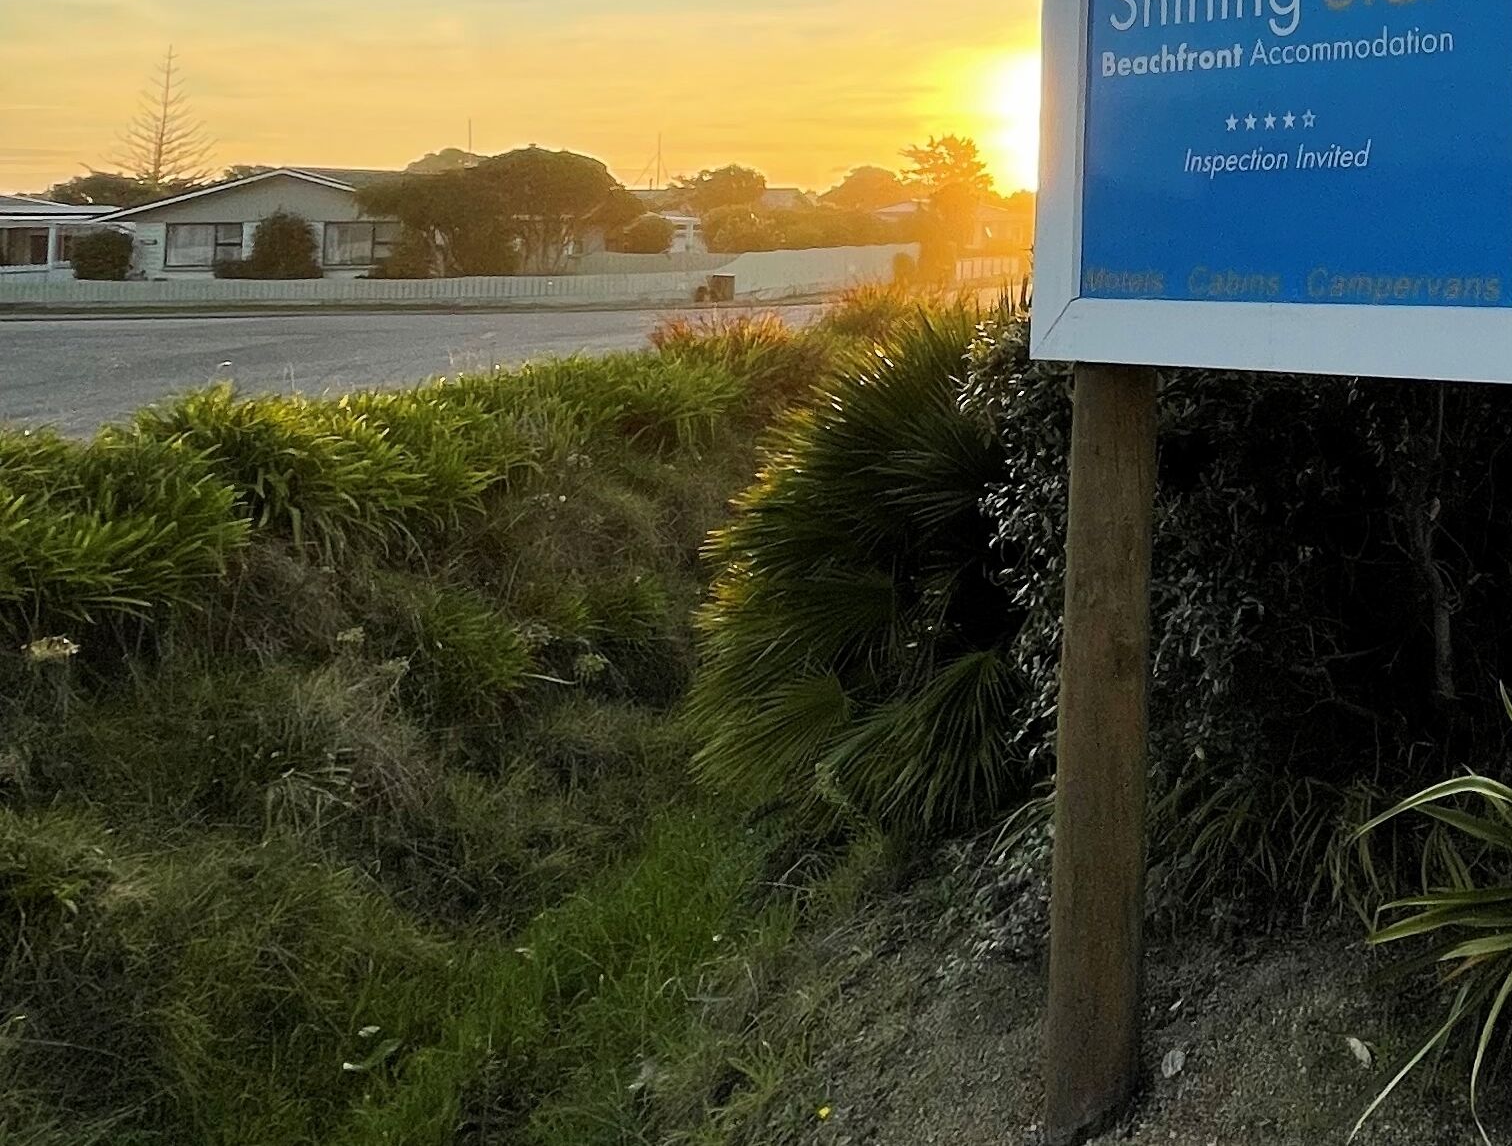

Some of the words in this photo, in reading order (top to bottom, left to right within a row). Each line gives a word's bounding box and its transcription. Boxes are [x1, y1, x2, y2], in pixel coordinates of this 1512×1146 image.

[1101, 45, 1244, 78] Beachfront
[1249, 26, 1454, 66] Accommodation
[1184, 148, 1289, 179] Inspection
[1296, 139, 1372, 169] Invited
[1188, 266, 1281, 296] Cabins
[1307, 265, 1500, 303] Campervans
